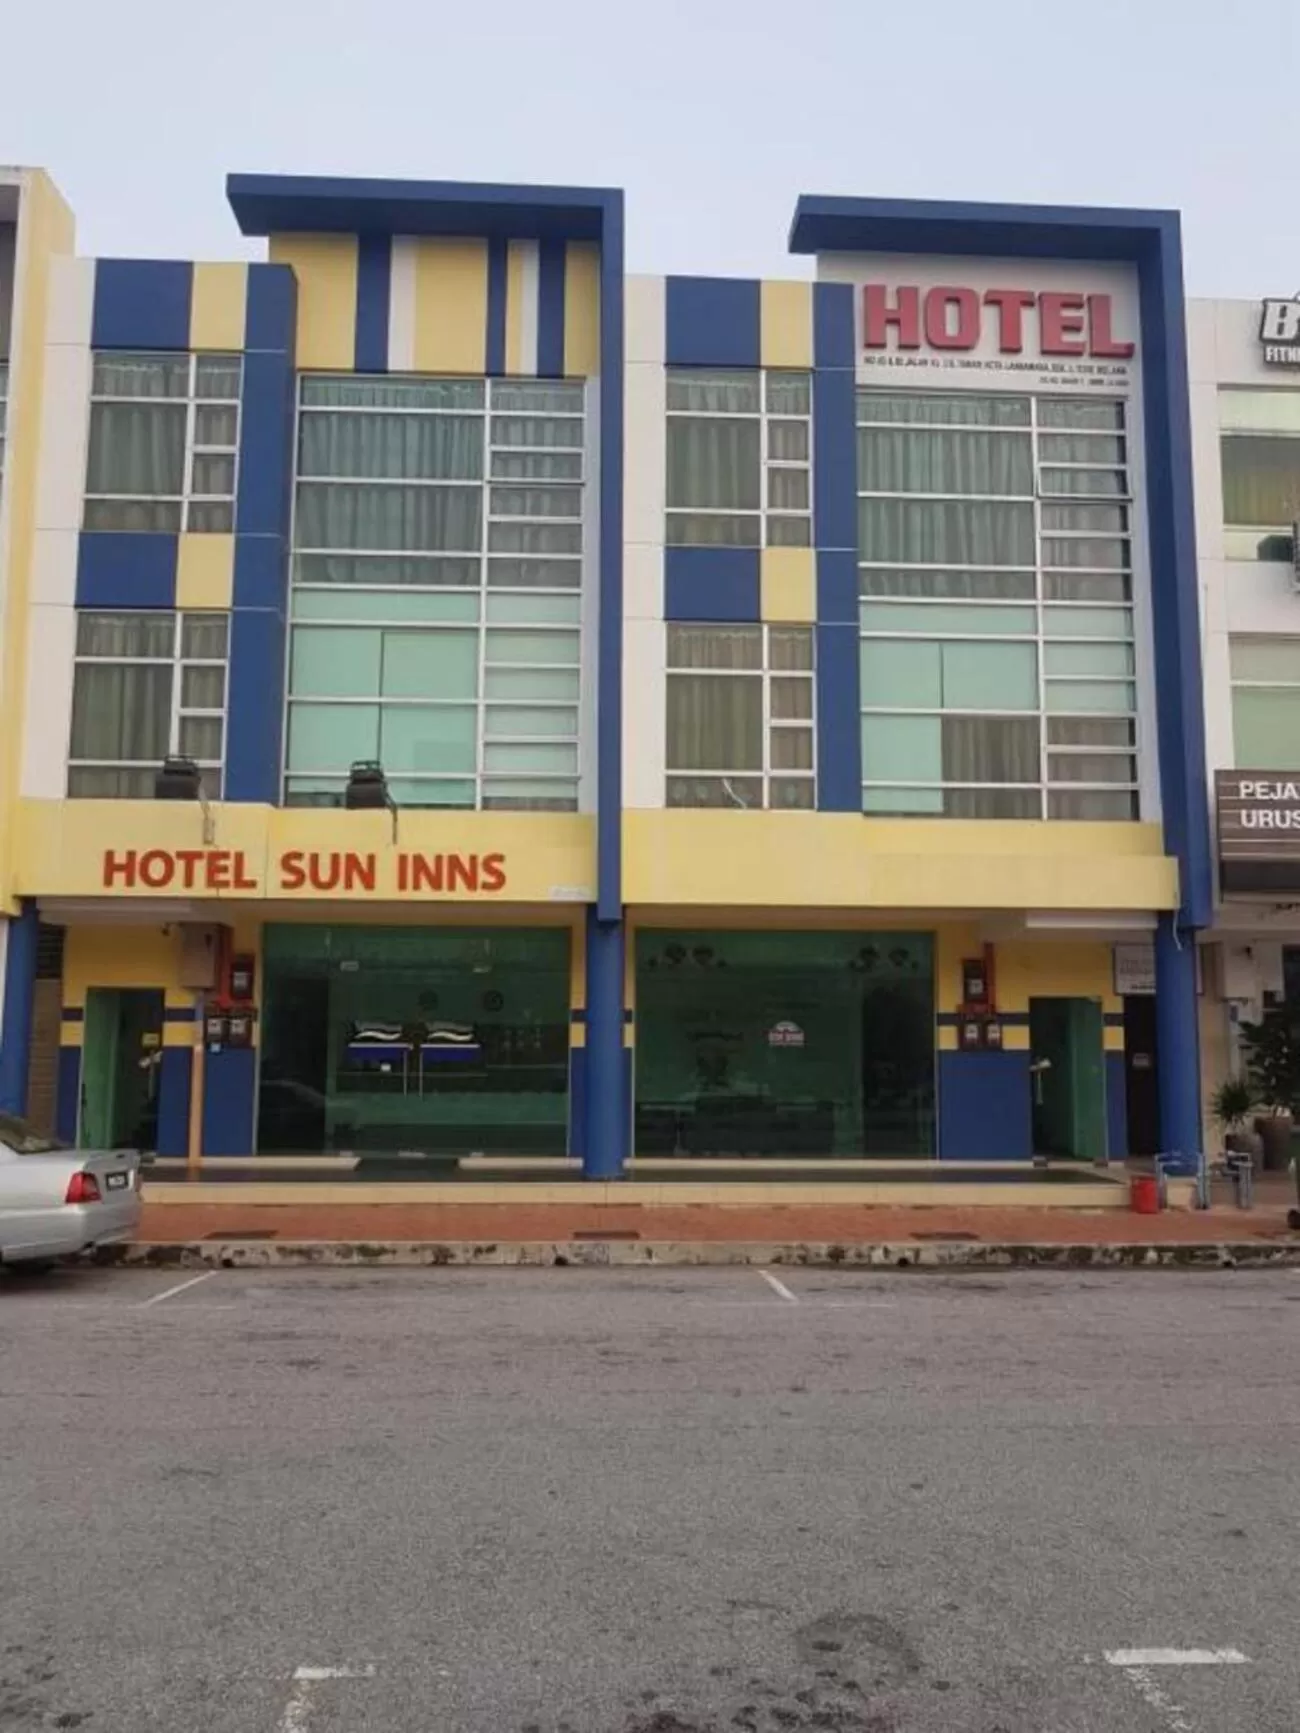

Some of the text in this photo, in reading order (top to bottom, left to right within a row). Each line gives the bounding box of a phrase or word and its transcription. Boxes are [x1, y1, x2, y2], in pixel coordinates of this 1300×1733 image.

[863, 284, 1136, 358] HOTEL
[1239, 780, 1300, 800] PEJA
[103, 849, 507, 892] HOTEL SUN INNS
